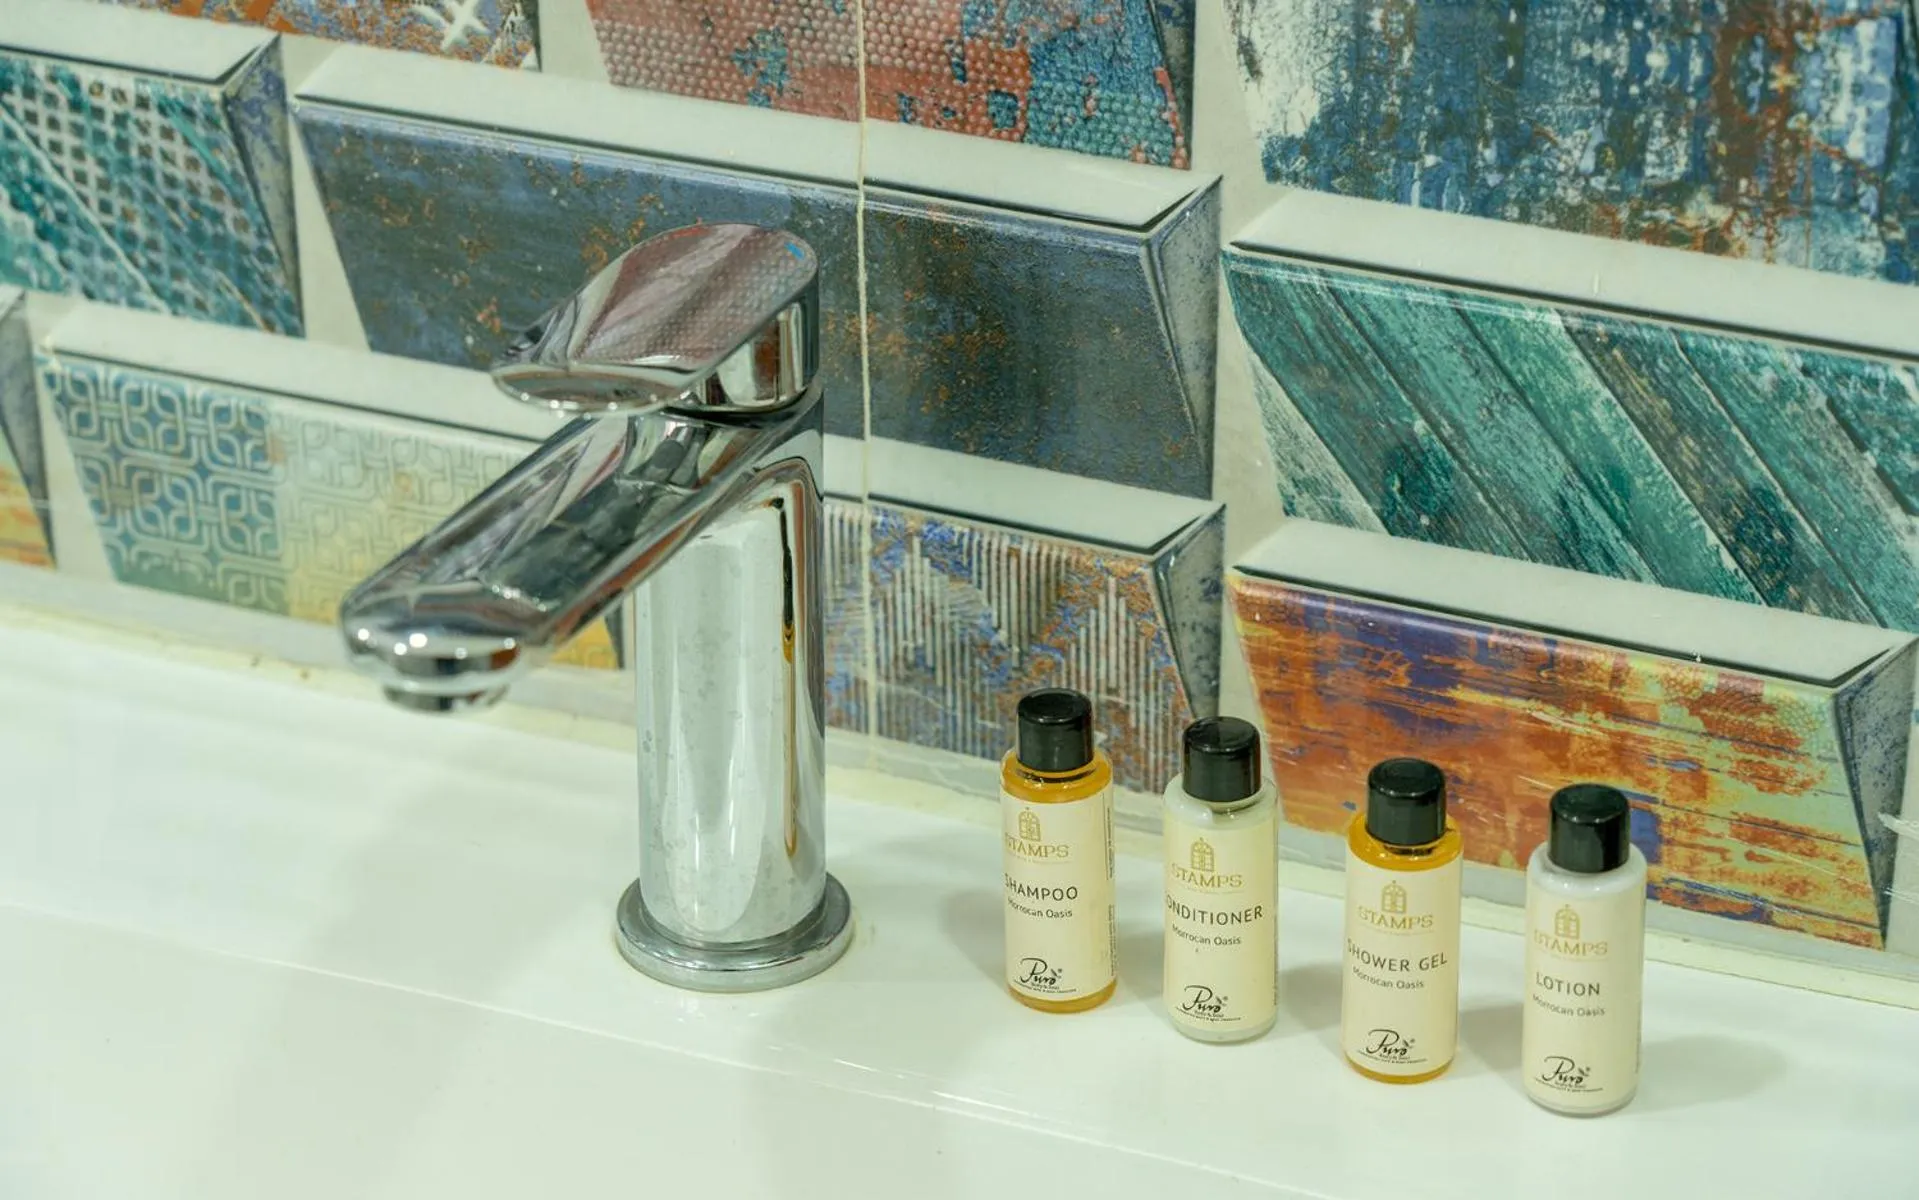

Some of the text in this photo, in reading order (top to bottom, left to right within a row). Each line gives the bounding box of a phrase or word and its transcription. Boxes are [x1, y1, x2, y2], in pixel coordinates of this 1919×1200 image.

[1004, 832, 1070, 858] STAMPS
[1171, 862, 1243, 888] STAMPS
[1045, 909, 1073, 918] Oasis
[1164, 891, 1263, 926] ONDITIONER
[1358, 905, 1434, 930] STAMPS
[1213, 936, 1242, 946] Oasis
[1533, 929, 1609, 956] STAMPS
[1347, 938, 1448, 972] SHOWER GEL
[1396, 980, 1425, 990] Oasis
[1536, 972, 1601, 997] LOTION
[1576, 1006, 1606, 1017] Oasis
